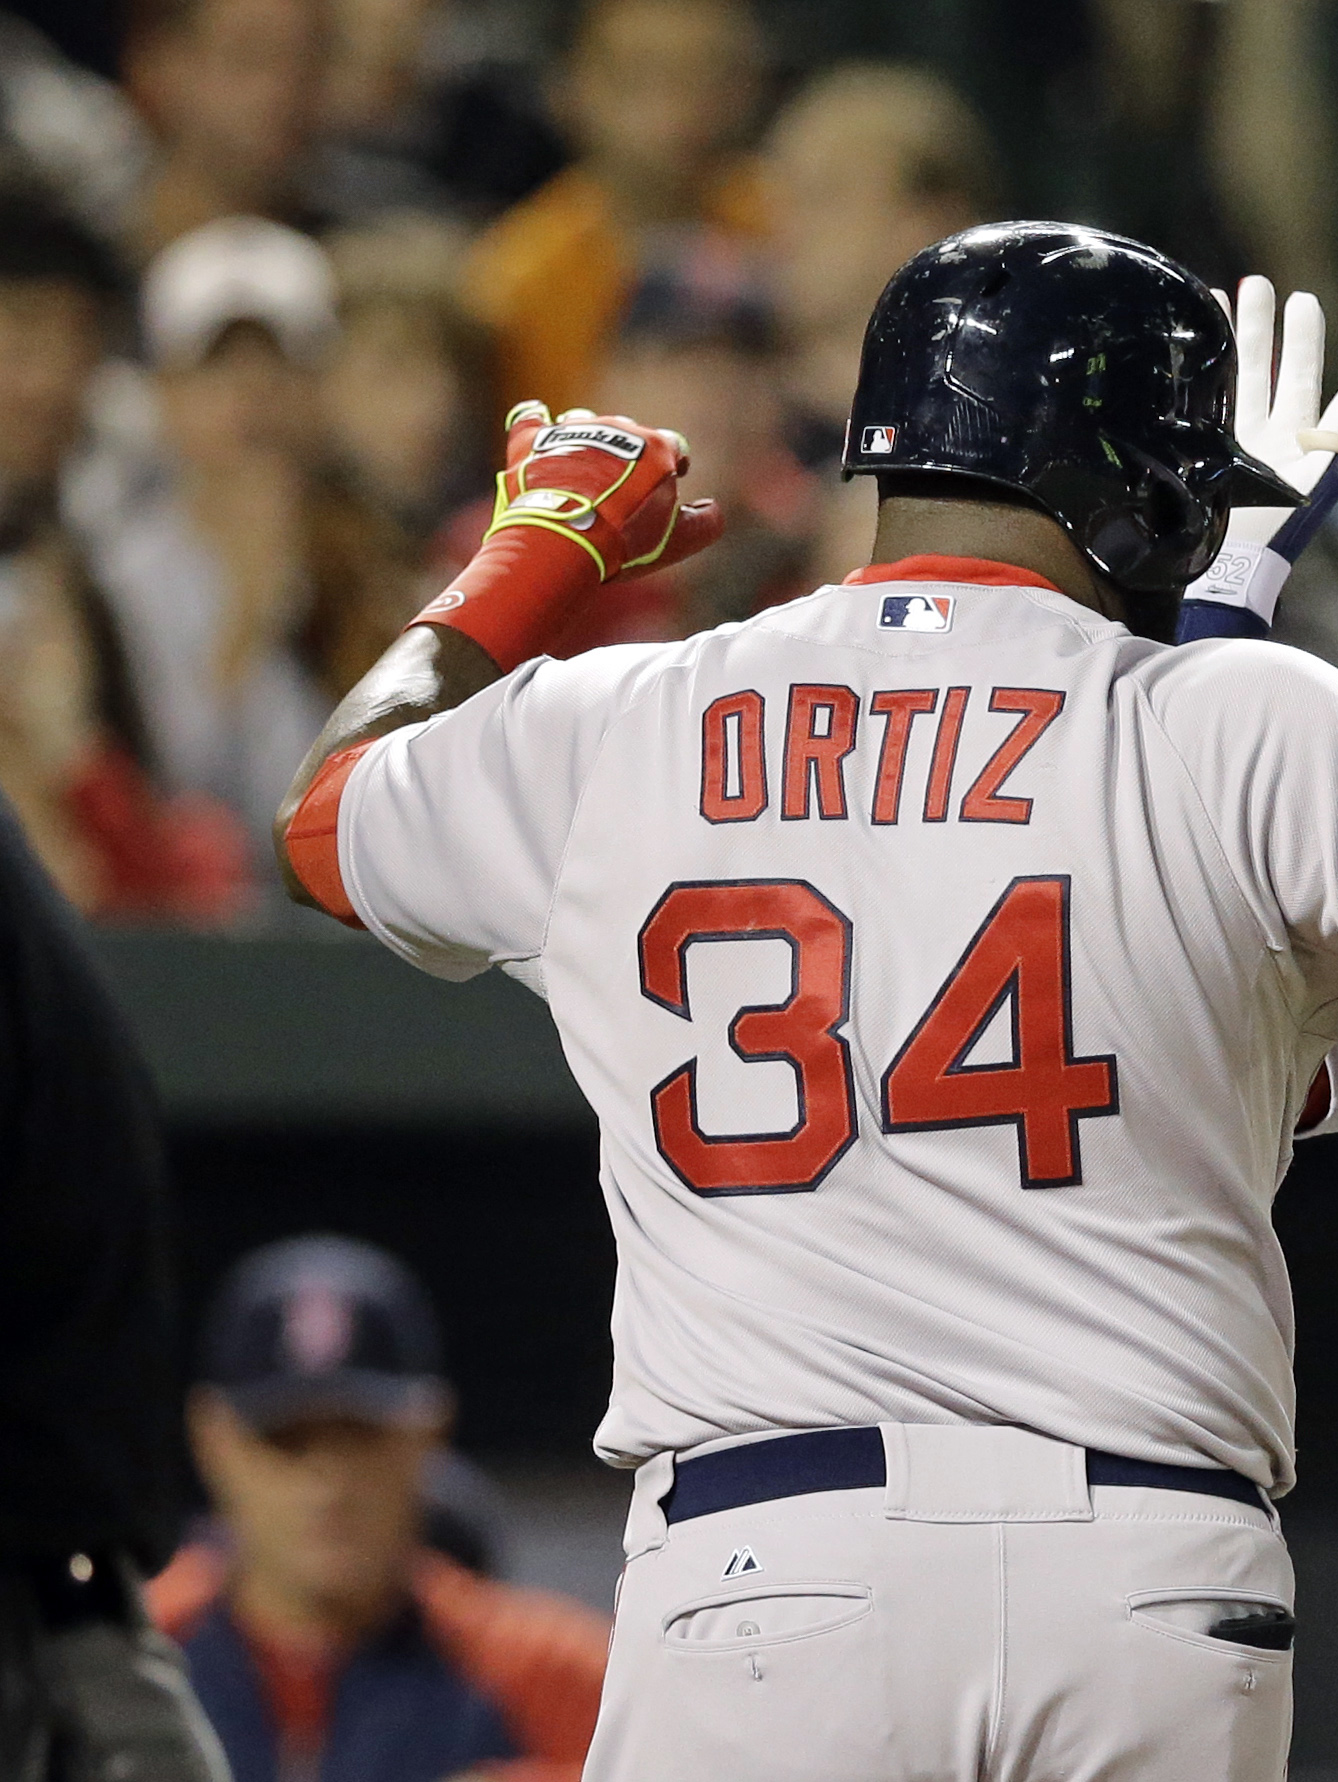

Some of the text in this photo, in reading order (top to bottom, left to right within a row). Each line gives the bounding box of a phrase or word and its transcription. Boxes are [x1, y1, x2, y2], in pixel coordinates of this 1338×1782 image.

[1206, 552, 1252, 587] 52
[699, 683, 1067, 825] ORTIZ
[637, 874, 1120, 1198] 34
